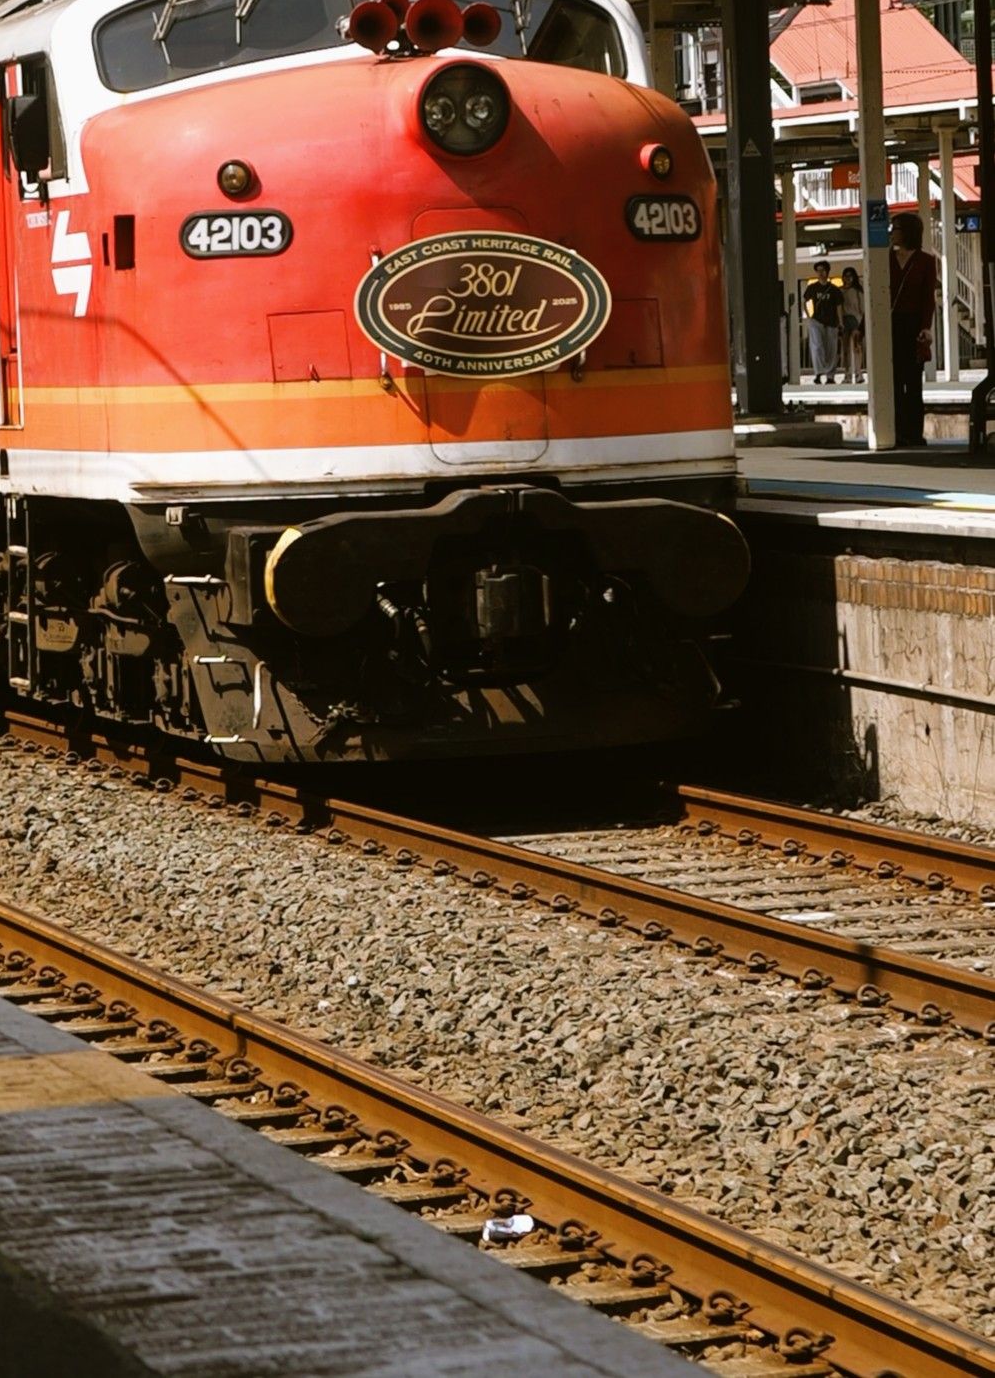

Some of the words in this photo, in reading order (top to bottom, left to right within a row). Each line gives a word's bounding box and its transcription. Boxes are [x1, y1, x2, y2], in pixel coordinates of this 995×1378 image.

[188, 216, 283, 252] 42103
[633, 203, 697, 235] 42103
[384, 250, 419, 275] EAST
[421, 239, 468, 256] COAST
[472, 238, 540, 255] HERITAGE
[542, 250, 573, 270] RAIL
[446, 263, 522, 298] 3801
[407, 295, 563, 342] Limited
[552, 297, 578, 306] 2025
[413, 350, 452, 368] 40TH
[456, 345, 562, 371] ANNIVERSARY
